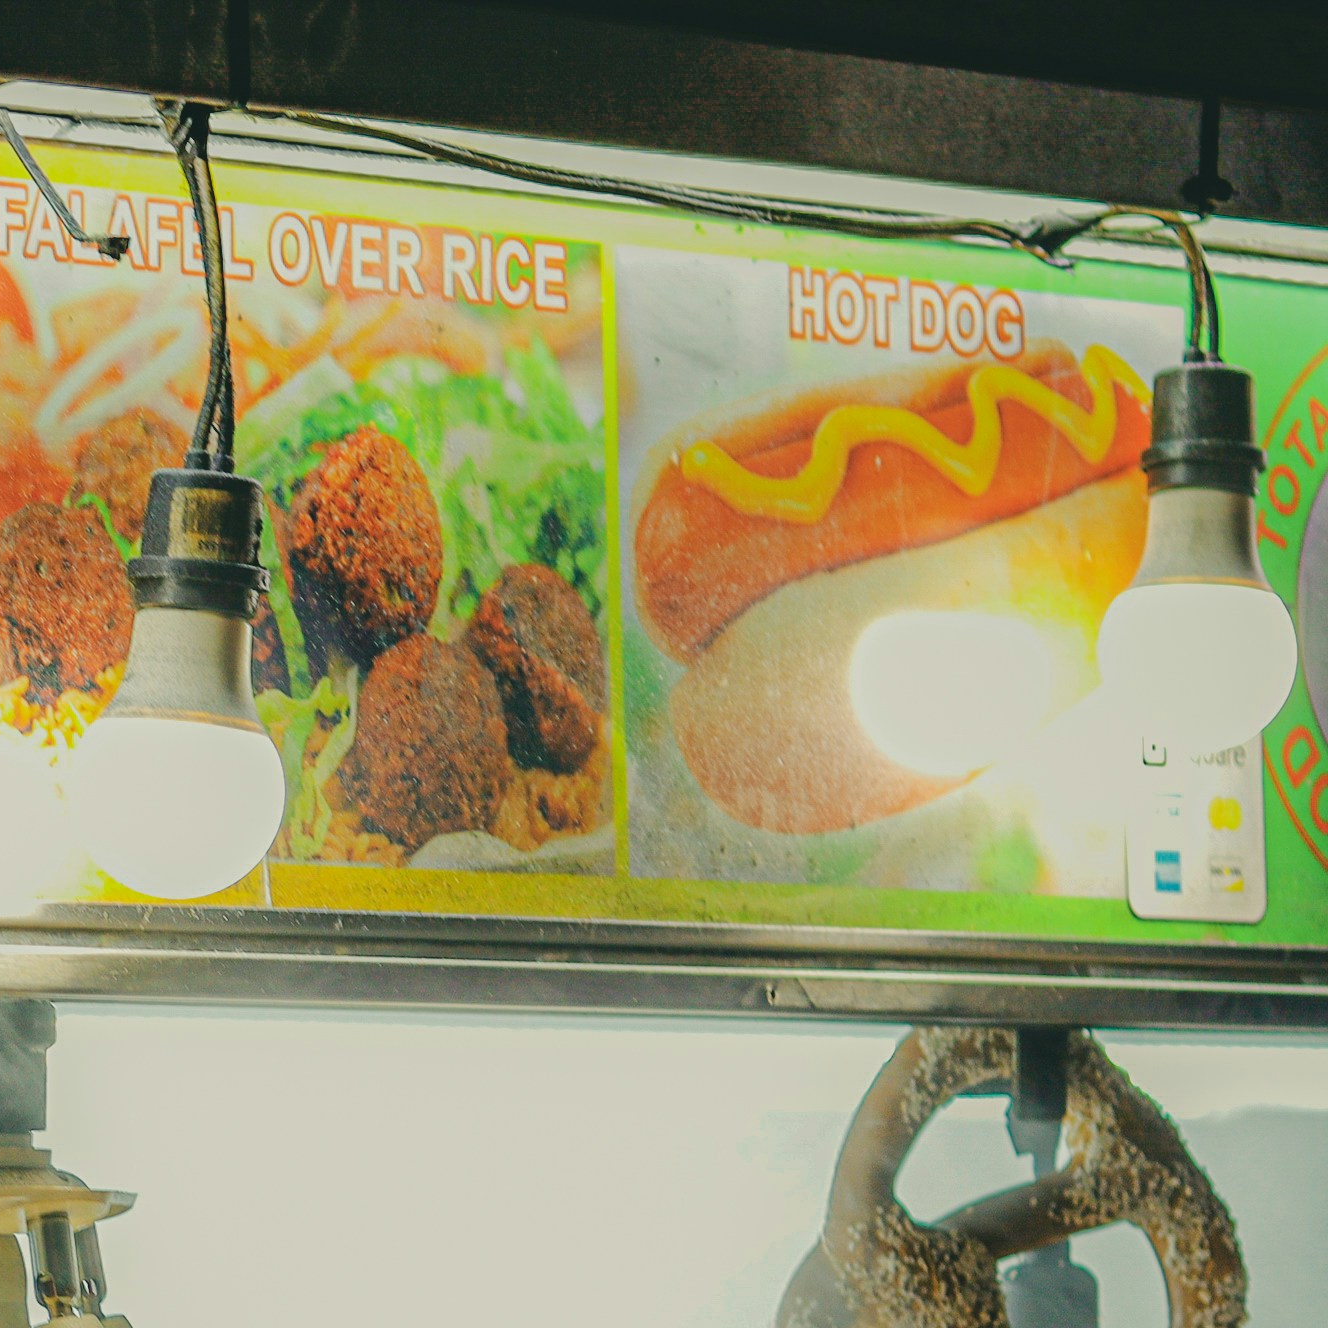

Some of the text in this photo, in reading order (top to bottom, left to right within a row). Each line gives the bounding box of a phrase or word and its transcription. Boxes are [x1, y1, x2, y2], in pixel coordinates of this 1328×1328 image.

[269, 211, 425, 297] OVER
[443, 227, 569, 313] RICE
[788, 264, 1026, 362] HOT DOG
